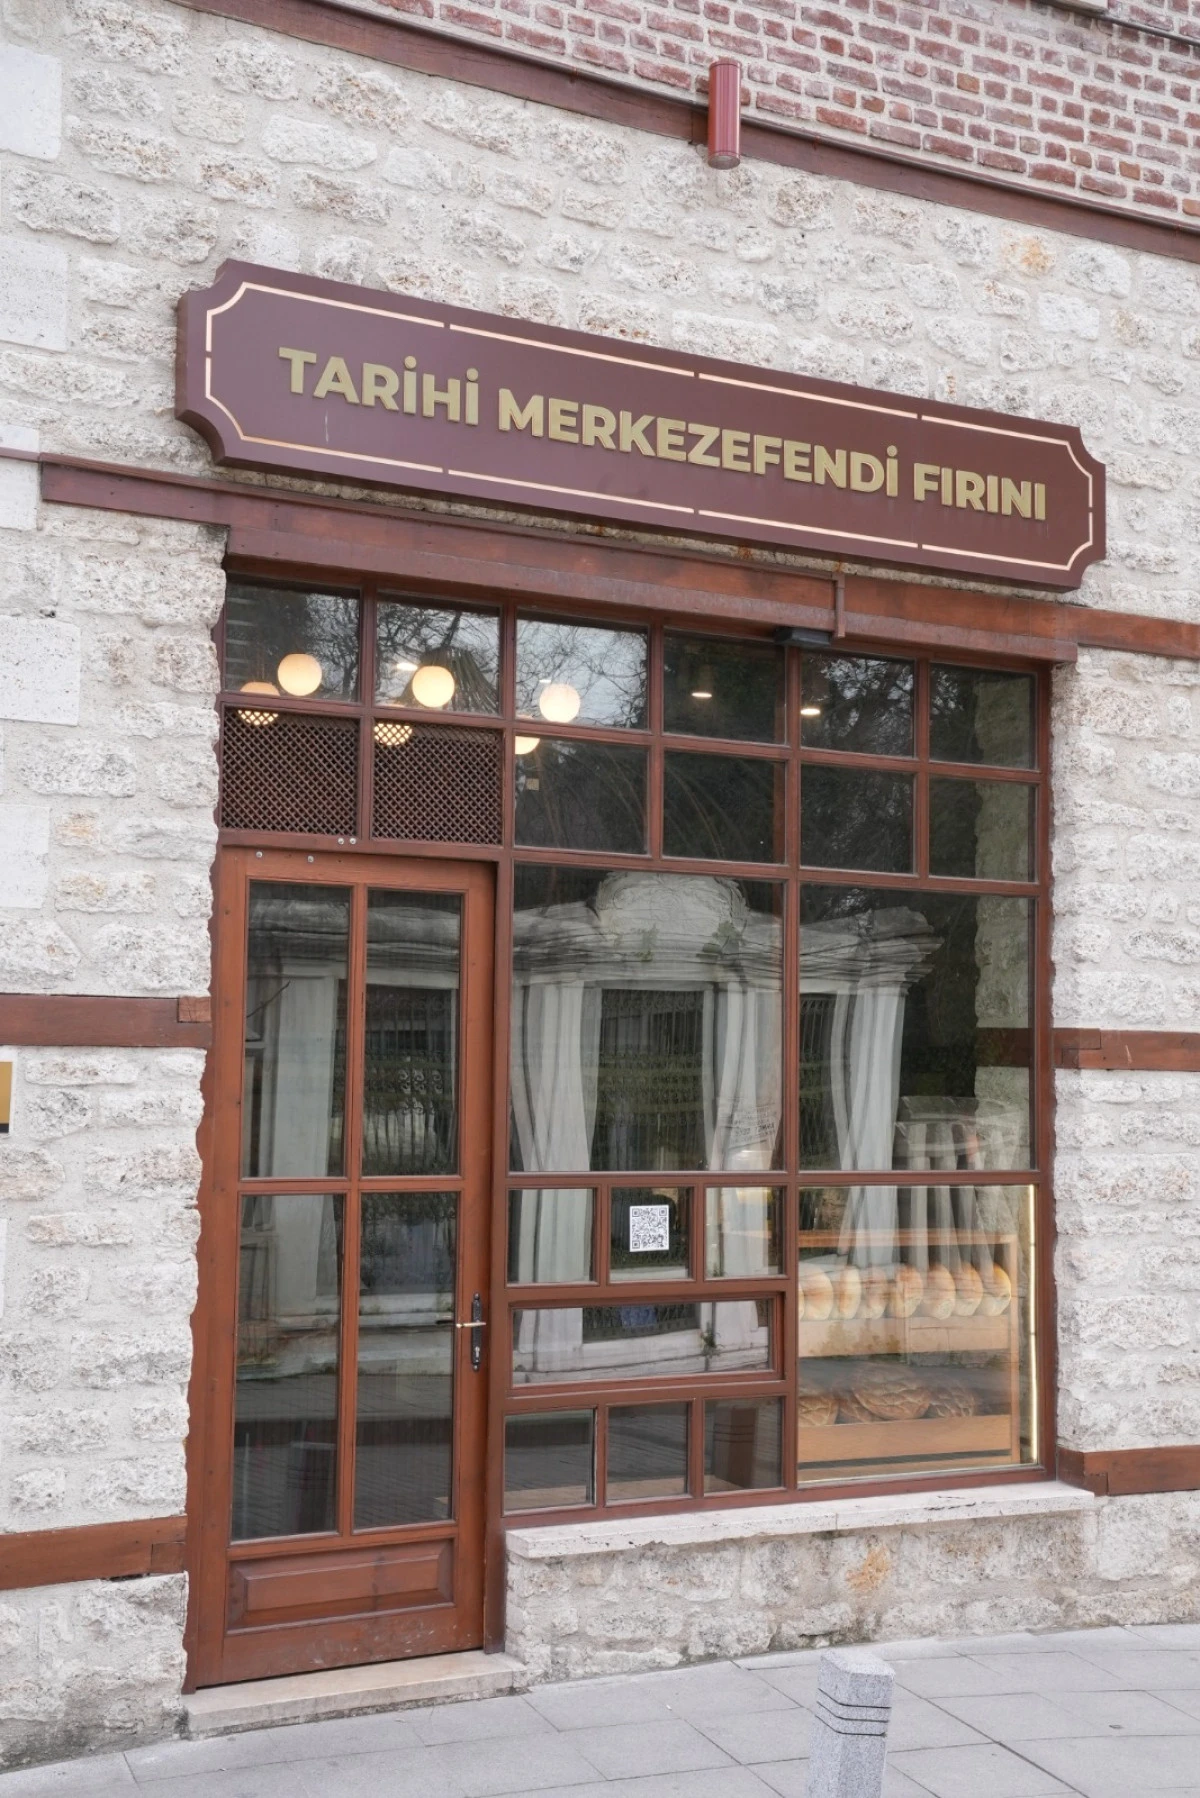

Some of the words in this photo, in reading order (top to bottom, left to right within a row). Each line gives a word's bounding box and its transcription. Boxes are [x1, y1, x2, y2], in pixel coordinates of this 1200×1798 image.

[278, 346, 479, 426] TARİHİ
[497, 387, 899, 498] MERKEZEFENDİ
[912, 461, 1047, 521] FIRINI
